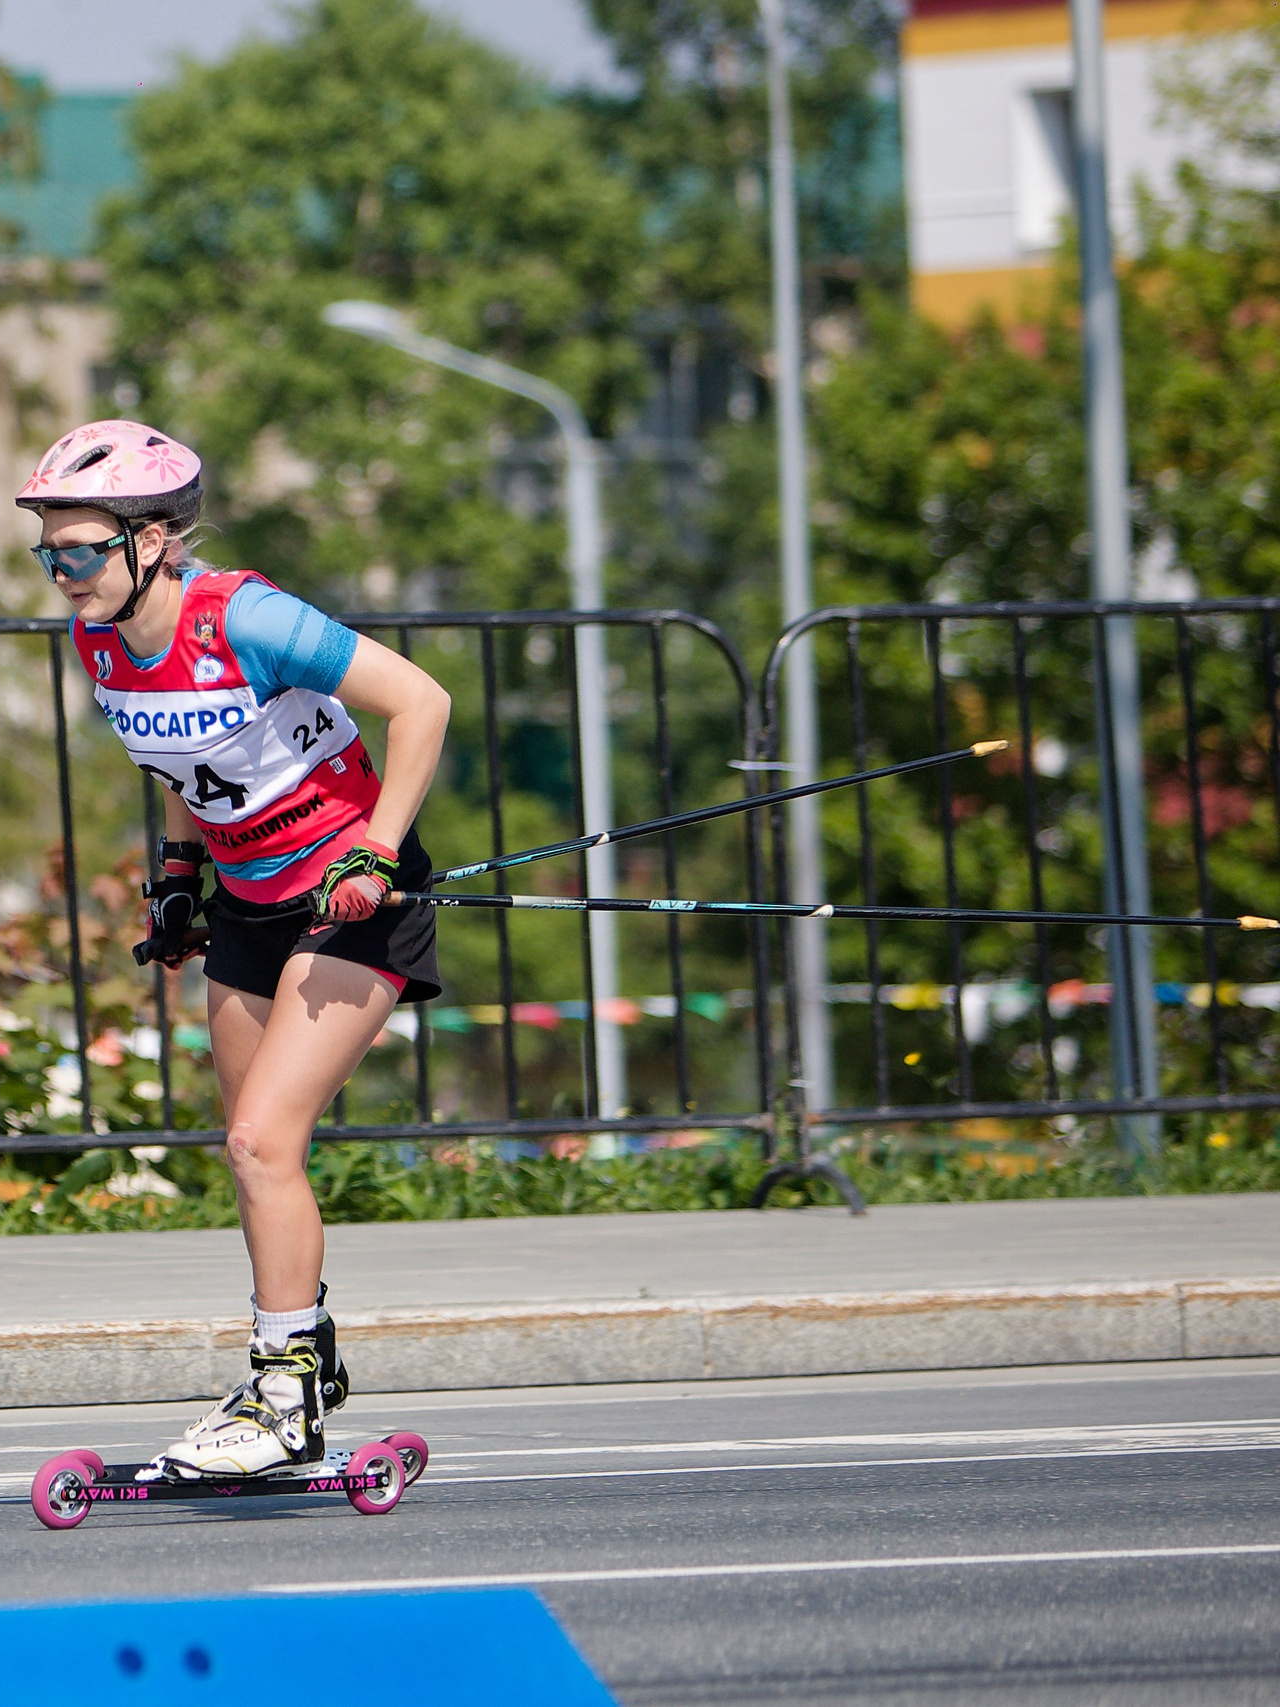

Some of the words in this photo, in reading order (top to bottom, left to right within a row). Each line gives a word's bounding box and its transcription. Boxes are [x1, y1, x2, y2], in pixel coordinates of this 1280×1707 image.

[115, 706, 245, 737] ФОСАГРО
[292, 706, 334, 754] 24
[651, 900, 695, 910] KV+
[307, 1478, 344, 1491] WAY
[349, 1477, 377, 1489] SKI
[78, 1487, 114, 1500] WAY
[120, 1487, 148, 1499] SKI
